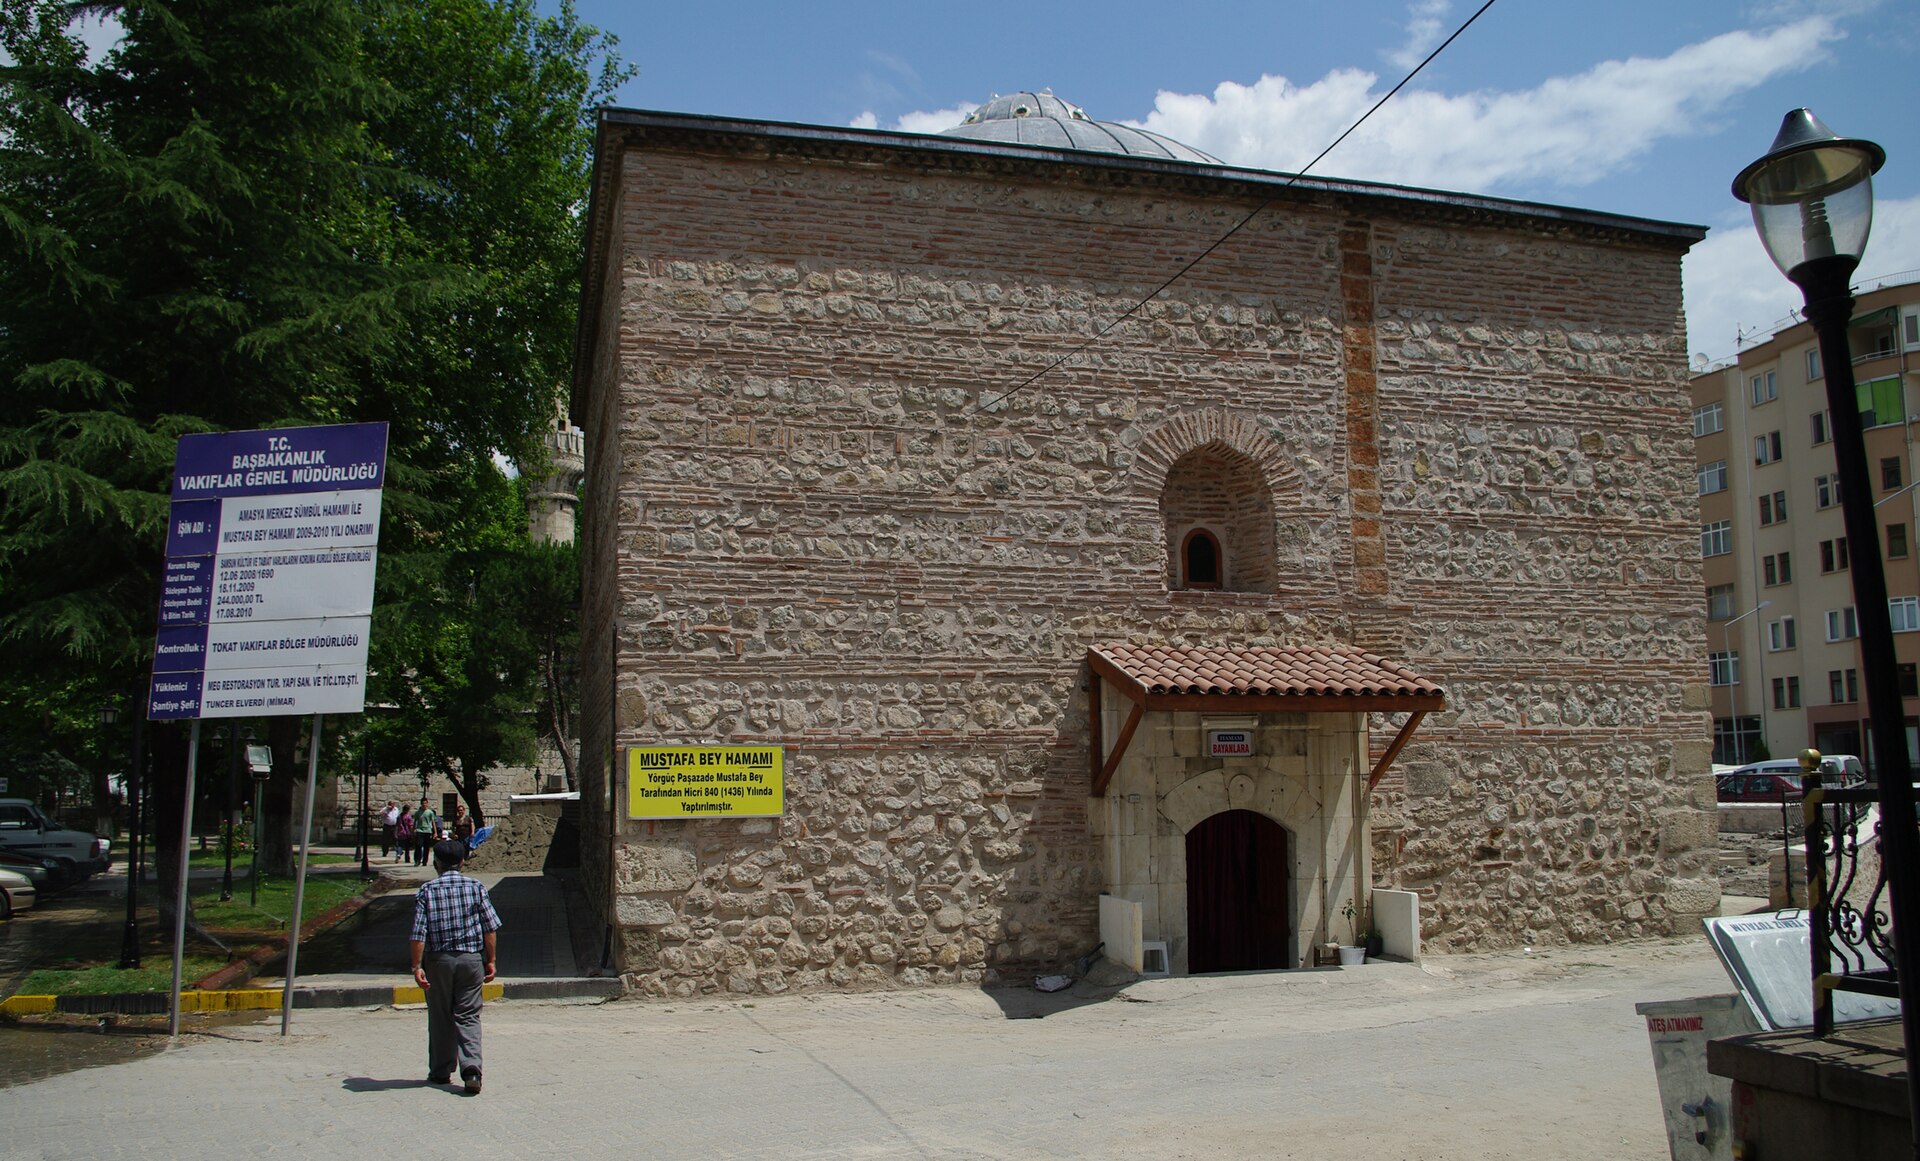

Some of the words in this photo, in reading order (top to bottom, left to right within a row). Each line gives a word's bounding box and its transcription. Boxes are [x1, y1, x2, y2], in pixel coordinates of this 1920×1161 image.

[269, 437, 291, 451] T.C.
[232, 450, 326, 471] BAŞBAKANLIK
[180, 474, 242, 490] VAKIFLAR
[246, 470, 288, 486] GENEL
[292, 462, 378, 484] MÜDÜRLÜĞÜ
[239, 509, 265, 522] AMASYA
[266, 507, 293, 520] MERKEZ
[293, 504, 321, 518] SÜMBÜL
[322, 504, 350, 517] HAMAMI
[351, 501, 362, 515] İLE
[178, 520, 192, 537] İŞİN
[192, 521, 204, 534] ADI
[223, 529, 253, 543] MUSTAFA
[254, 528, 268, 541] BEY
[269, 527, 295, 540] HAMAMI
[296, 525, 329, 539] 2009-2010
[330, 524, 344, 537] YILI
[345, 523, 374, 536] ONARIMI
[255, 594, 264, 603] TL
[213, 642, 237, 653] TOKAT
[240, 640, 278, 651] VAKIFLAR
[279, 637, 306, 650] BÖLGE
[307, 634, 359, 648] MÜDÜRLÜĞÜ
[155, 682, 188, 692] Yüklenici
[208, 681, 221, 691] MEG
[222, 679, 265, 690] RESTORASYON
[266, 678, 281, 689] TUR.
[282, 677, 296, 688] YAPI
[297, 676, 312, 687] SAN.
[312, 676, 322, 687] VE
[152, 700, 179, 713] Şantiye
[180, 699, 195, 711] Şefi
[206, 699, 234, 709] TUNCER
[235, 697, 265, 707] ELVERDİ
[266, 695, 295, 708] (MİMAR)
[640, 753, 695, 766] MUSTAFA
[699, 752, 722, 765] BEY
[725, 752, 773, 765] HAMAMI
[648, 773, 675, 785] Yörgüç
[677, 773, 714, 785] Paşazade
[716, 772, 747, 782] Mustafa
[749, 772, 763, 784] Bey
[640, 787, 682, 798] Tarafından
[684, 787, 703, 797] Hicri
[704, 787, 719, 797] 840
[721, 786, 744, 798] (1436)
[746, 786, 773, 796] Yılında
[681, 802, 733, 813] Yaptırılmıştır.
[1648, 1018, 1666, 1034] ATEŞ
